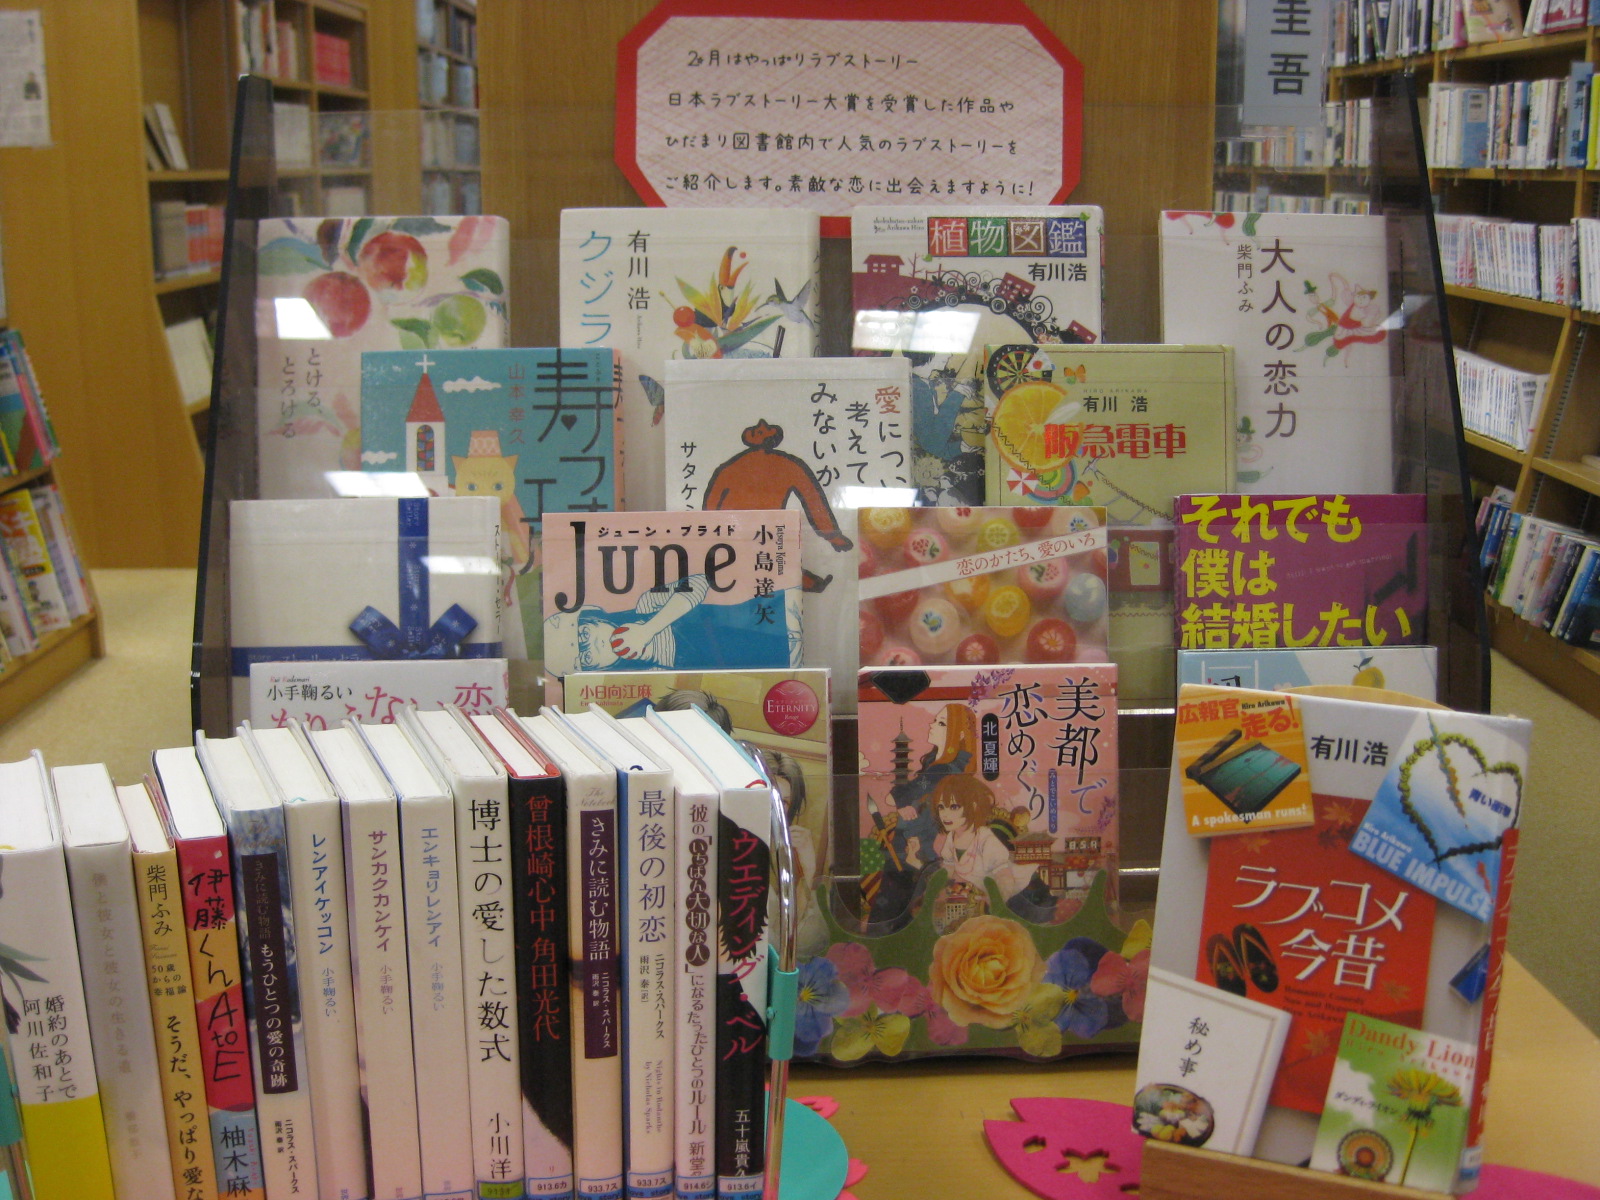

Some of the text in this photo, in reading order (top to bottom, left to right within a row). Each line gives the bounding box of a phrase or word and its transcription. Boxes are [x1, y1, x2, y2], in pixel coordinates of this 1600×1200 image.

[627, 230, 651, 310] 有川浩
[1028, 262, 1088, 281] 有川浩
[1236, 244, 1254, 313] 柴門ふみ
[1259, 238, 1299, 439] 大人の恋力
[280, 357, 298, 439] とろける
[507, 362, 526, 445] 山本幸久
[810, 382, 840, 487] みないか
[845, 400, 871, 484] 考えて
[1043, 423, 1187, 460] 阪急電車
[597, 524, 737, 538] ジューン・ブライド
[955, 532, 1096, 576] 恋のかたち、愛のいろ
[1181, 494, 1362, 544] それでも
[554, 521, 737, 614] June
[753, 524, 776, 626] 小島達矢
[1180, 548, 1278, 599] 僕は
[1180, 601, 1412, 649] 結婚したい
[267, 685, 353, 701] 小手鞠るい
[579, 684, 653, 700] 小日向江麻
[767, 698, 817, 713] ETERNITY
[1178, 697, 1241, 725] 広報官
[998, 682, 1050, 822] 恋めぐり
[1048, 676, 1108, 815] 美都で
[1310, 734, 1389, 768] 有川浩
[1192, 815, 1200, 827] A
[1204, 809, 1272, 828] spokesman
[147, 864, 173, 937] 柴門ふみ
[312, 833, 334, 955] レンアイケッコン
[368, 830, 393, 952] サンカクカンケイ
[421, 827, 443, 948] エンキョリレンアイ
[588, 817, 611, 961] きみに読む物語
[637, 789, 667, 943] 最後の初恋
[1232, 865, 1409, 933] ラブコメ
[1351, 829, 1494, 919] BLUE IMPULSE
[188, 868, 234, 988] 伊藤くん
[468, 799, 512, 1062] 博士の愛した数式
[1278, 928, 1386, 991] 今昔
[260, 943, 288, 1088] もうひとつの愛の奇跡
[321, 967, 337, 1017] 小手鞠るい
[379, 964, 394, 1015] 小手鞠るい
[431, 962, 445, 1012] 小手鞠るい
[530, 937, 561, 1042] 角田光代
[601, 971, 611, 1049] ニコラス・スパークス
[655, 953, 665, 1040] ニコラス・スパークス
[22, 998, 54, 1102] 阿川佐和子
[45, 994, 77, 1099] 婚約のあとで
[1179, 1017, 1210, 1078] 秘め事
[1349, 1017, 1476, 1070] Dandy Lion
[220, 1124, 252, 1198] 柚木麻
[487, 1112, 512, 1180] 小川洋
